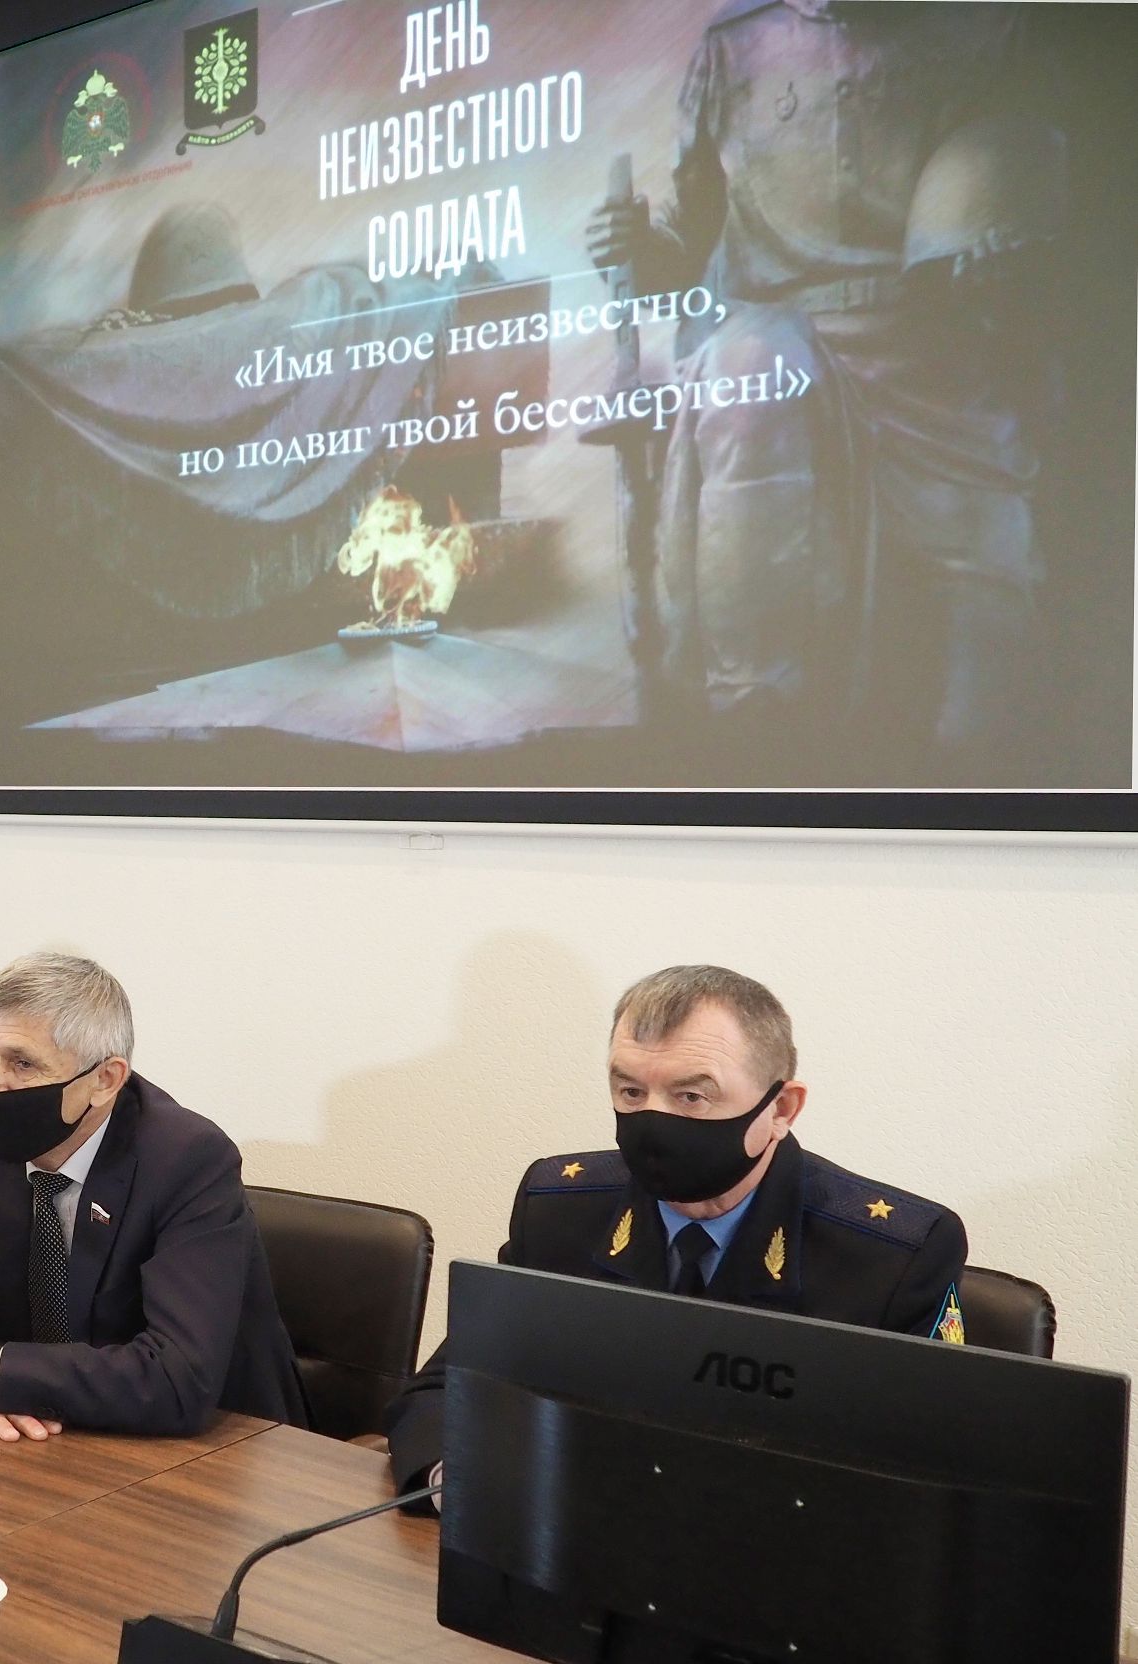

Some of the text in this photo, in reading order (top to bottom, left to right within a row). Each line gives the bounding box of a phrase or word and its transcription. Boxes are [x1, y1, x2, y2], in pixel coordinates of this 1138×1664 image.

[400, 0, 489, 93] ДЕНЬ
[320, 71, 582, 200] НЕИЗВЕСТНОГО
[368, 185, 526, 283] СОЛДАТА
[235, 286, 726, 388] «Имя твое неизвестно,
[178, 354, 812, 477] но подвиг твой бессмертен!»
[692, 1352, 795, 1399] AOC
